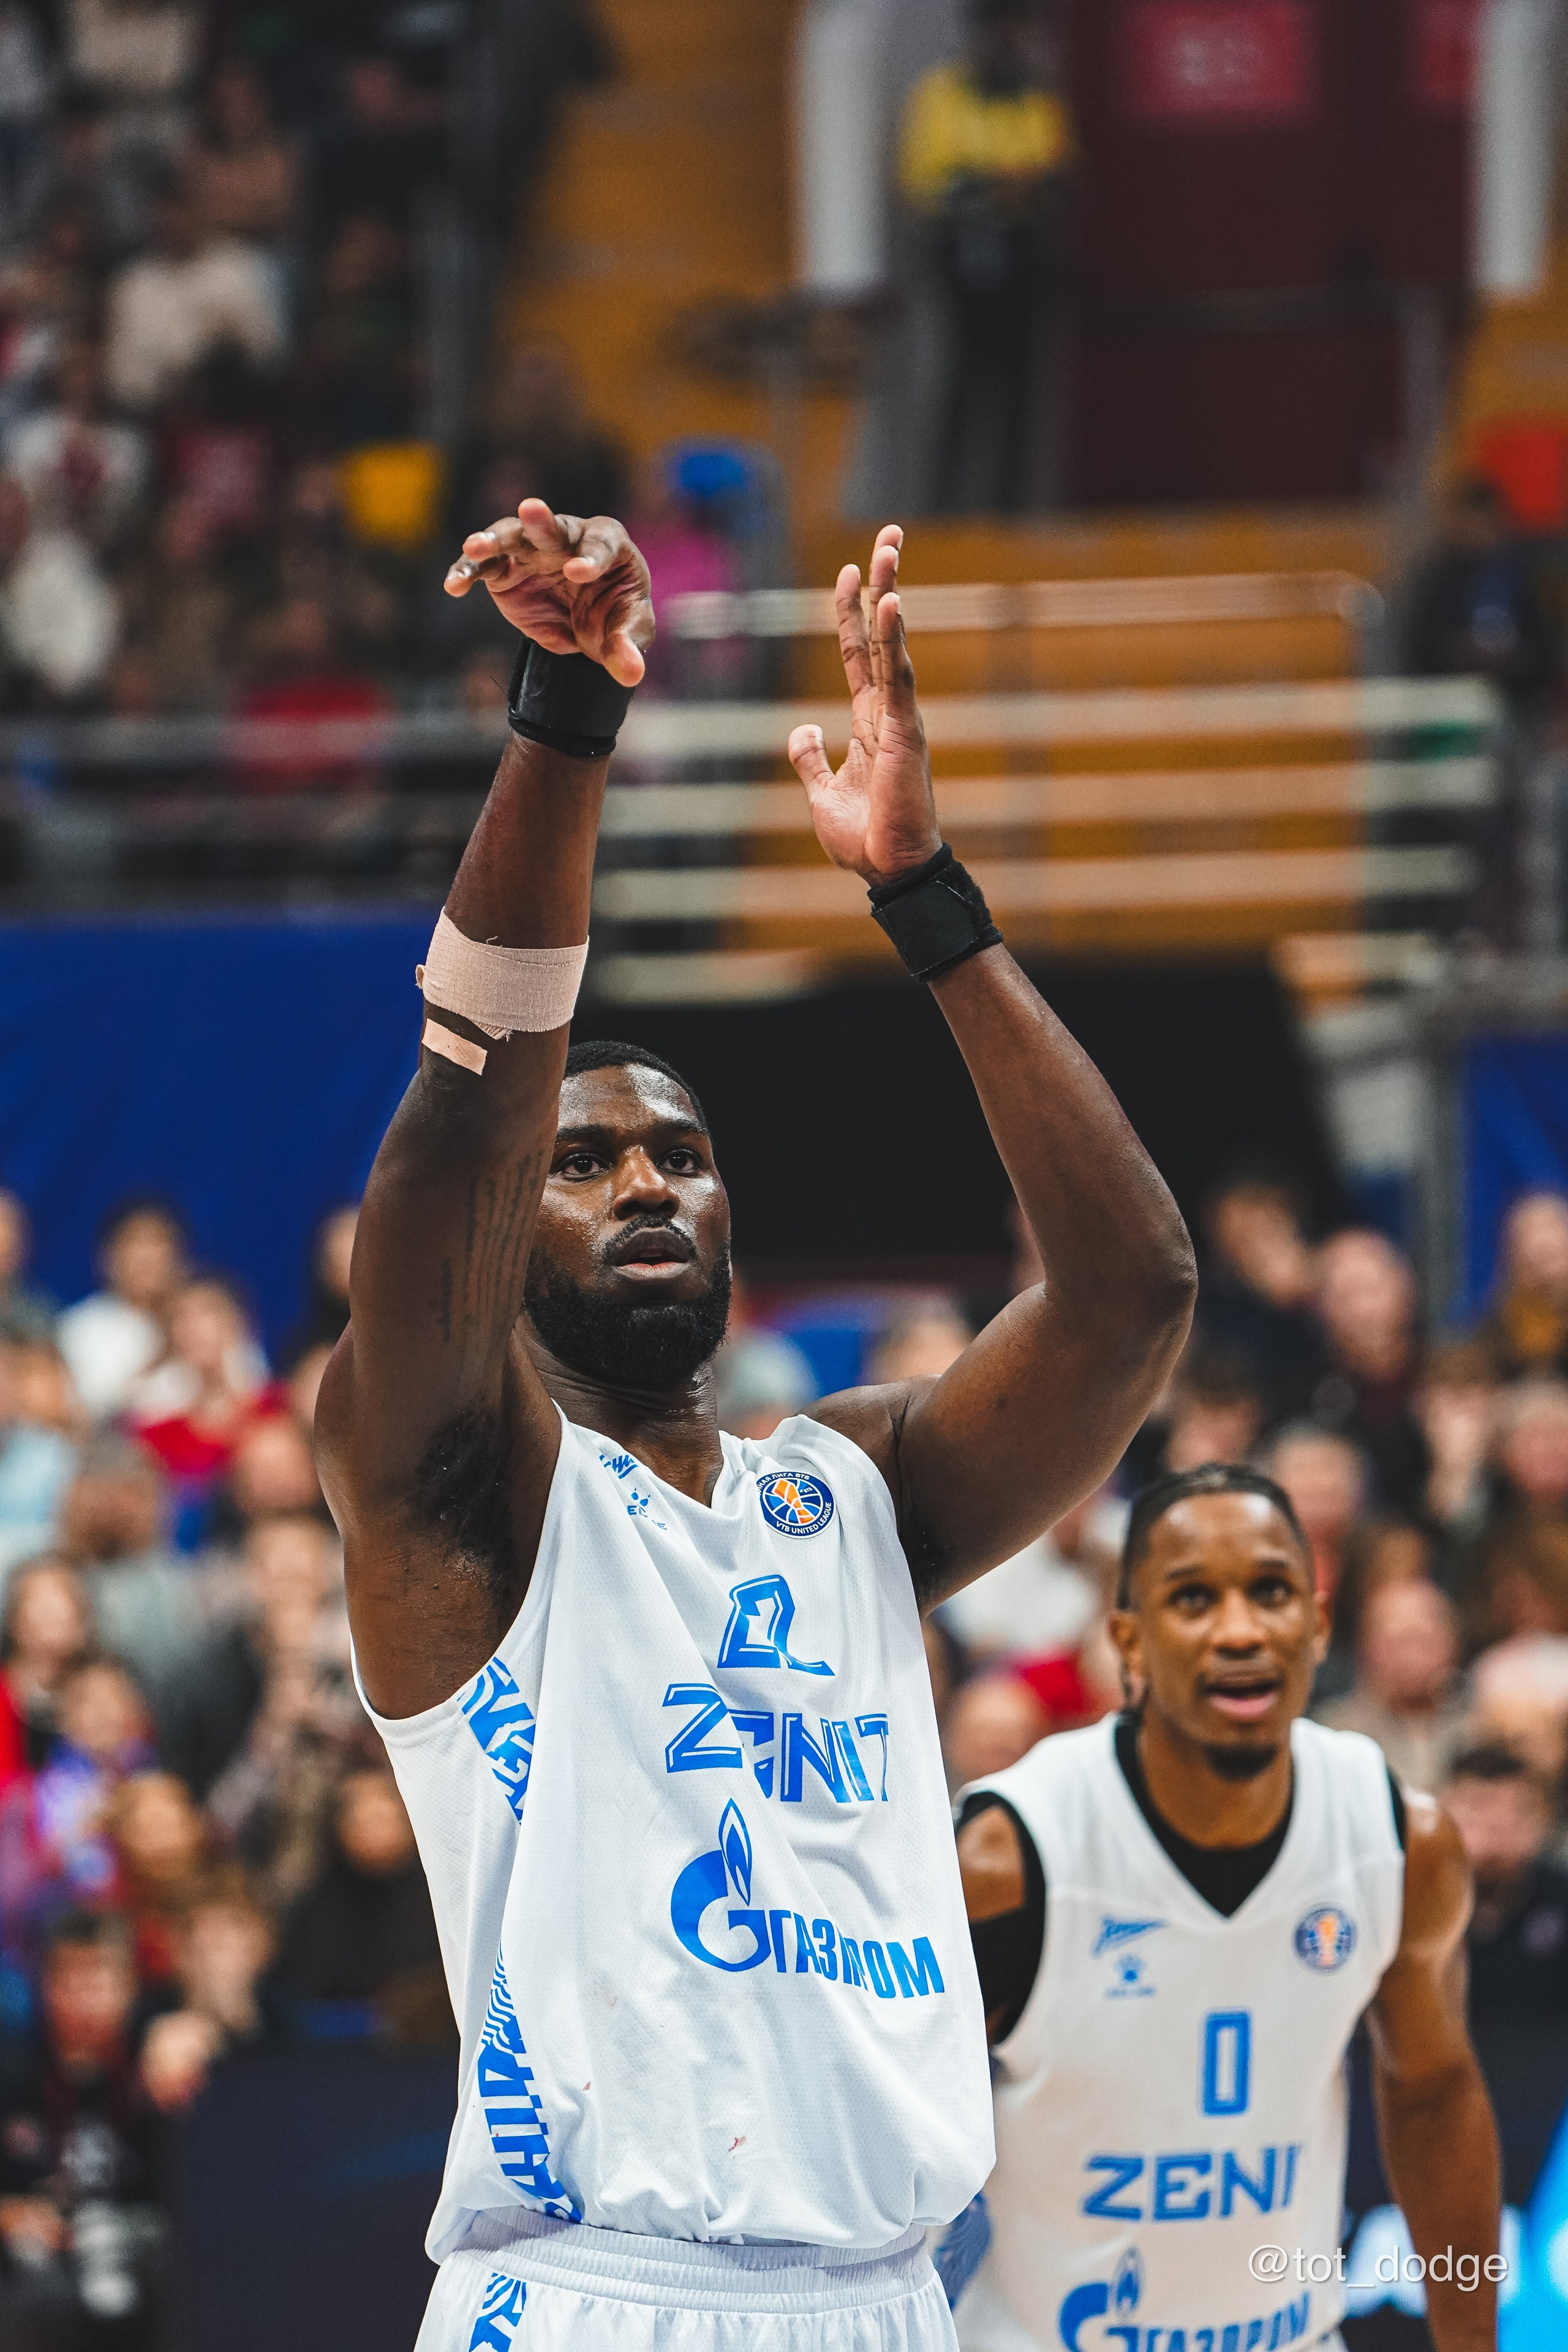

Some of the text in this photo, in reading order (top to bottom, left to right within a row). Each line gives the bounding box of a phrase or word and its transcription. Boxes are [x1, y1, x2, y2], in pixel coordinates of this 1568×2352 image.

[776, 1502, 832, 1534] VTB UNITED LEAGUE
[1200, 2008, 1251, 2117] 0
